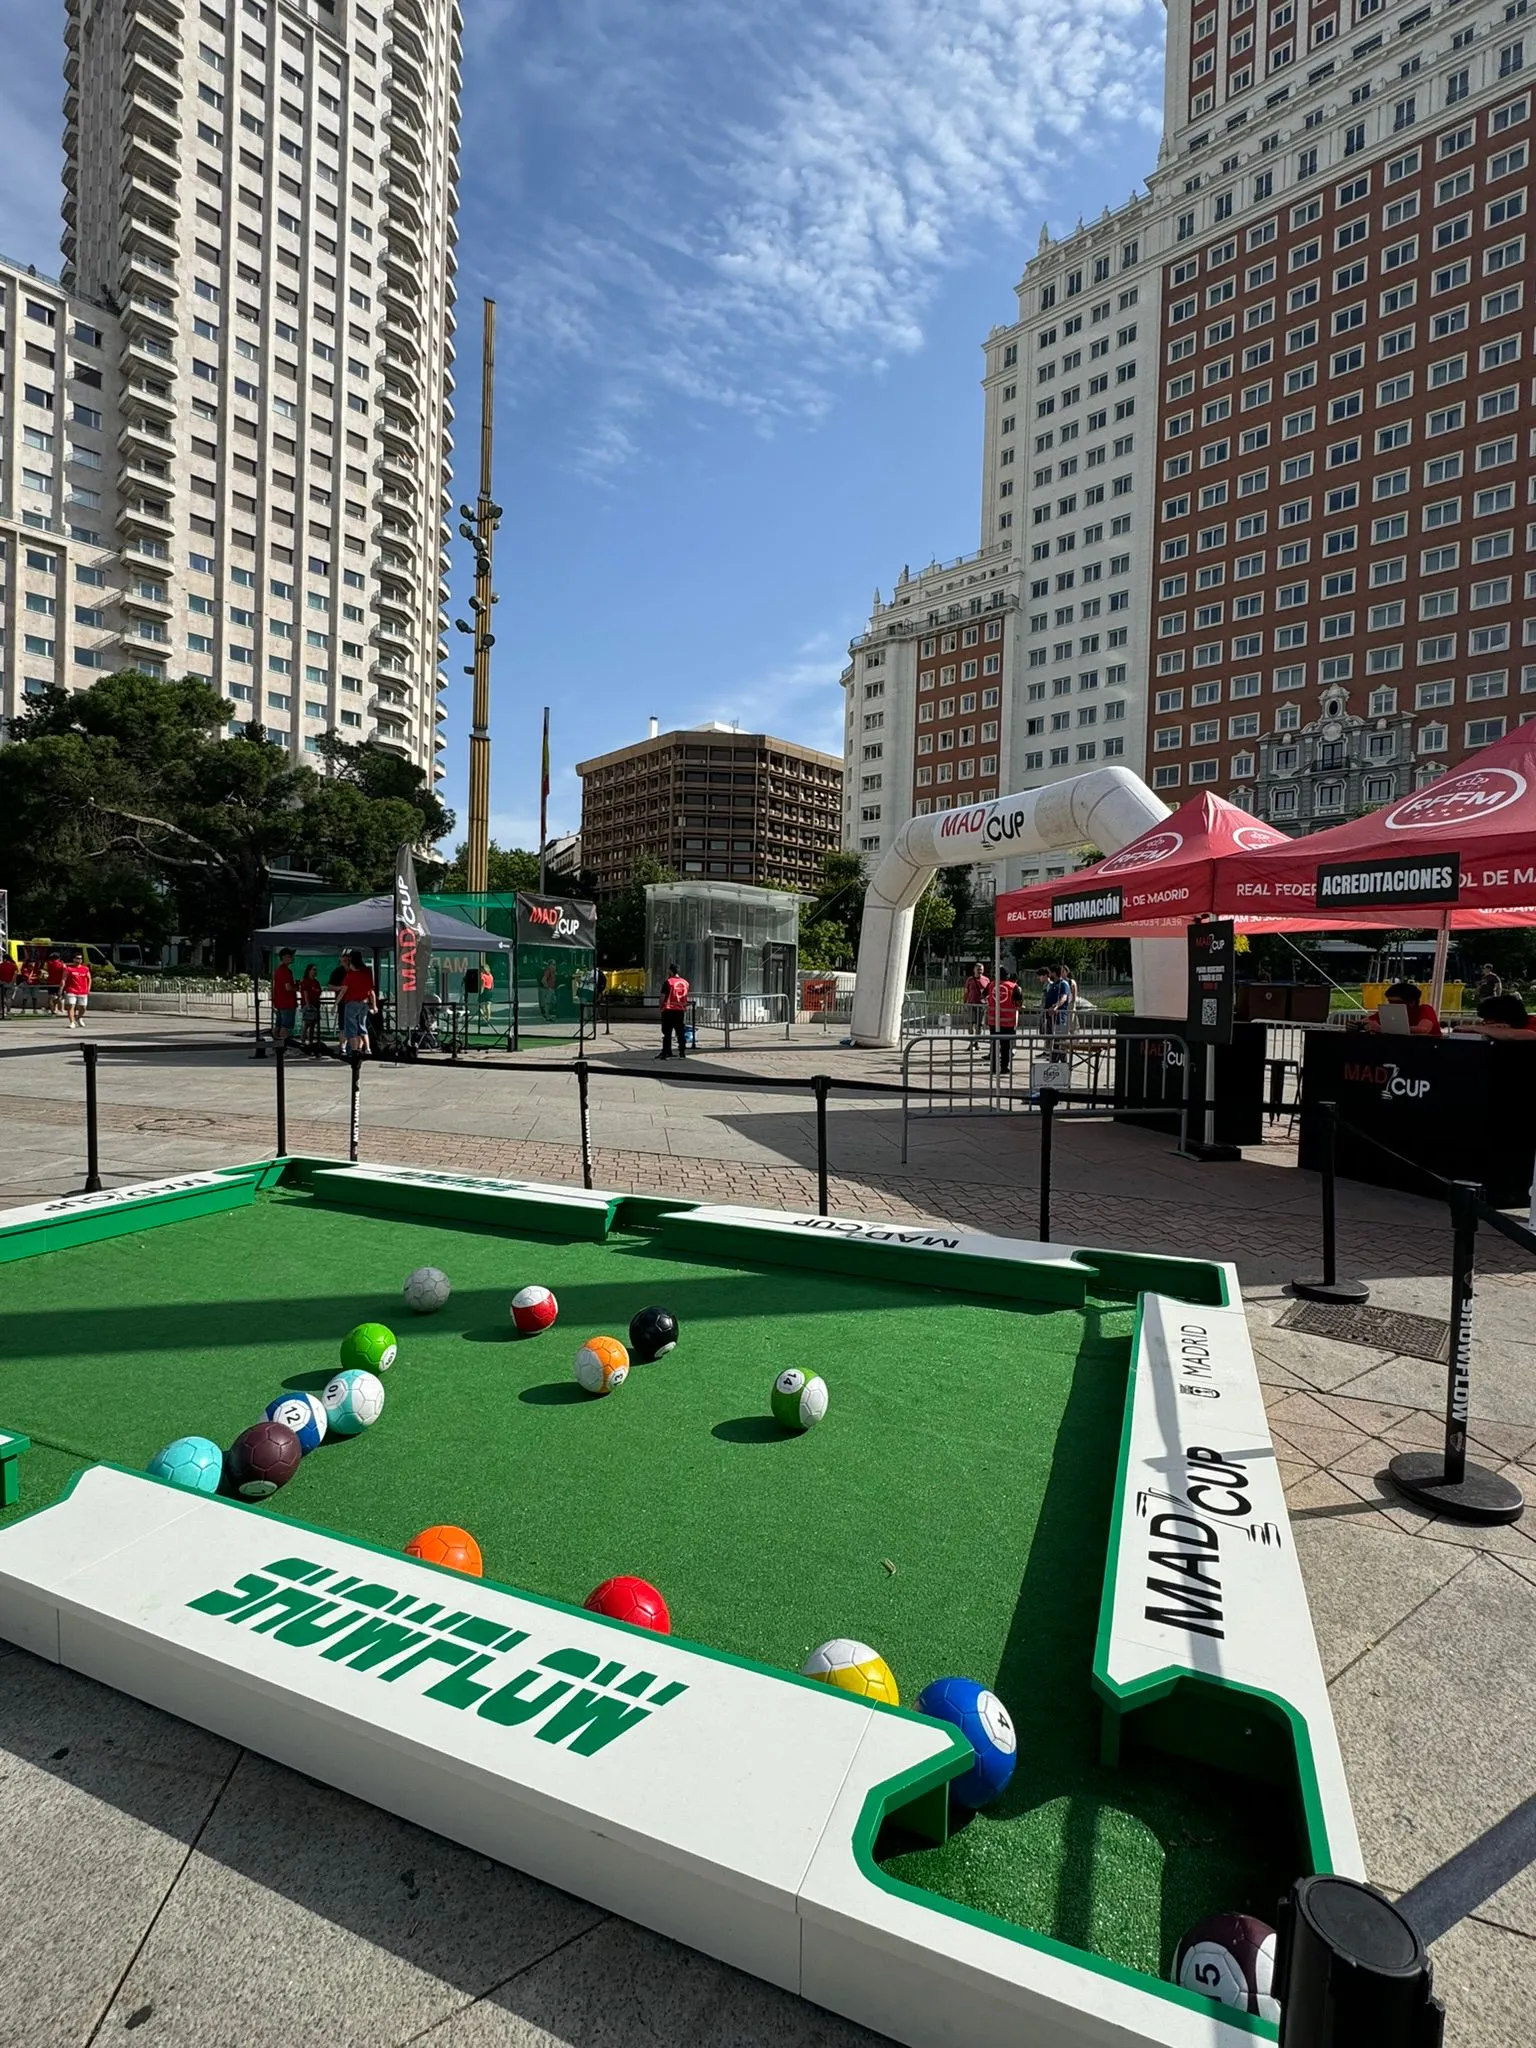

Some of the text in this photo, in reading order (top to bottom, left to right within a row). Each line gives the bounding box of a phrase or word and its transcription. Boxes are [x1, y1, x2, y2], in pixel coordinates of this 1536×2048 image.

[1403, 791, 1506, 814] RFFM
[941, 808, 1024, 842] MAD CUP
[1236, 883, 1271, 896] REAL
[1482, 869, 1509, 887] DE
[1322, 866, 1453, 896] ACREDITACIONES
[1007, 912, 1027, 921] REAL
[1133, 894, 1146, 907] DE
[1147, 887, 1190, 904] MADRID
[1053, 893, 1120, 922] INFORMACIÓN
[398, 875, 416, 992] MAD CUP
[528, 906, 580, 935] MAD CUP
[1211, 939, 1226, 951] CUP
[1344, 1063, 1430, 1098] MAD CUP
[44, 1178, 212, 1212] MAD CUP
[792, 1219, 960, 1249] MAD CUP
[1181, 1324, 1213, 1379] MADRID
[1451, 1298, 1473, 1422] SHOWFLOW
[327, 1385, 339, 1401] 10
[783, 1373, 797, 1386] 14
[284, 1406, 301, 1424] 12
[1144, 1446, 1252, 1640] MAD CUP
[184, 1557, 690, 1757] SHOWFLOW
[997, 1711, 1011, 1731] 4
